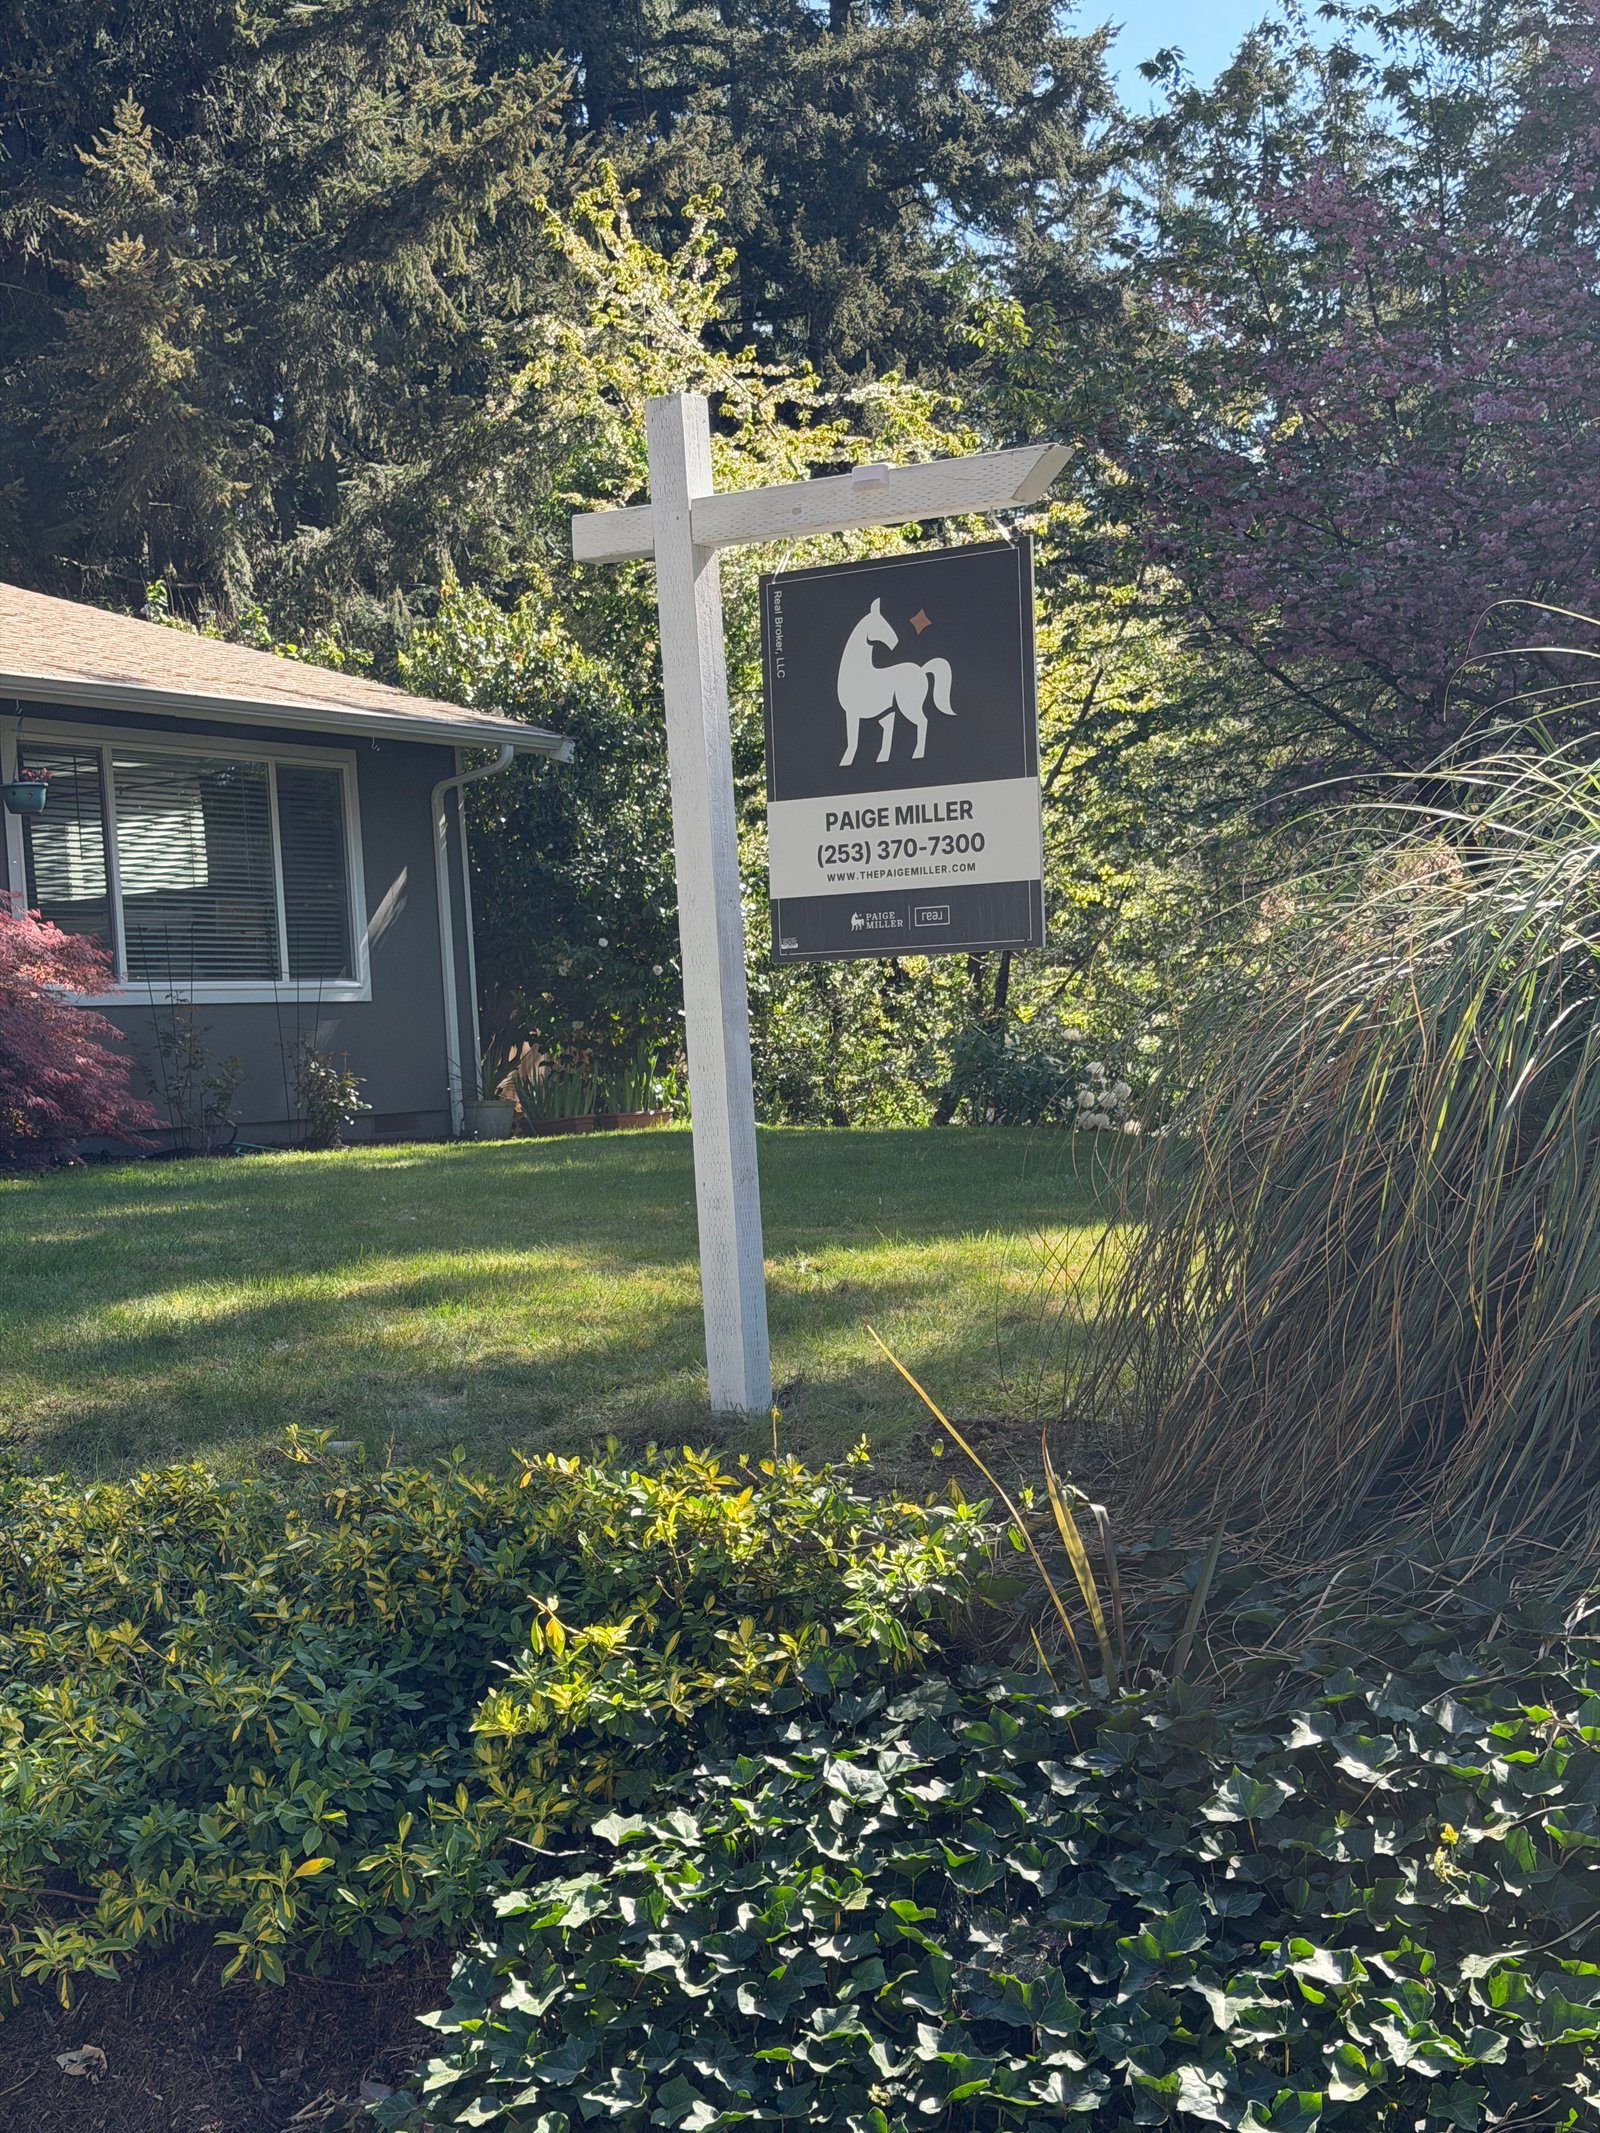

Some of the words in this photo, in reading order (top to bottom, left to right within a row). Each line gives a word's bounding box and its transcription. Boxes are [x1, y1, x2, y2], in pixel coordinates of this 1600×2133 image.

[774, 590, 783, 614] Real
[774, 617, 784, 655] Broker,
[776, 658, 786, 679] LLC
[825, 807, 890, 832] PAIGE
[895, 800, 974, 826] MILLER
[817, 841, 872, 868] (253)
[877, 832, 986, 860] 370-7300
[827, 862, 976, 882] WWW.THEPAIGEMILLER.COM
[865, 911, 896, 921] PAIGE
[865, 919, 904, 930] MILLER
